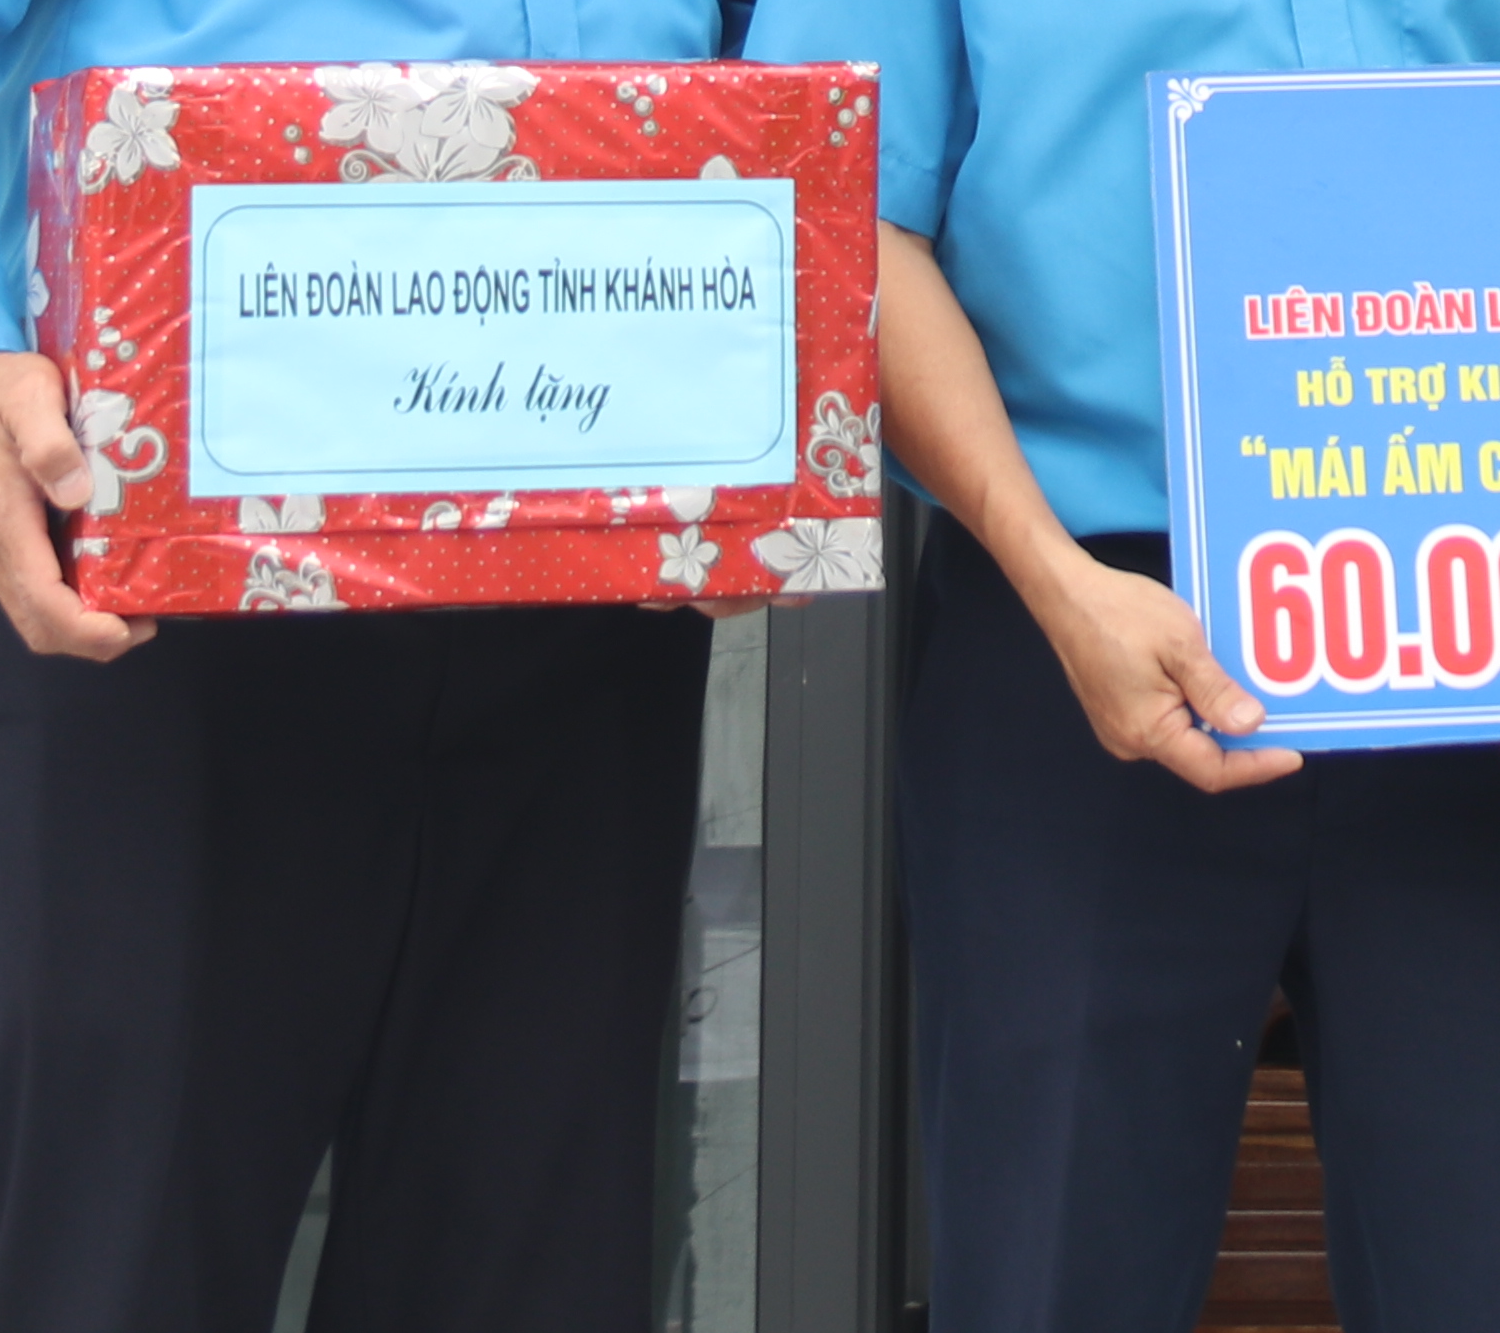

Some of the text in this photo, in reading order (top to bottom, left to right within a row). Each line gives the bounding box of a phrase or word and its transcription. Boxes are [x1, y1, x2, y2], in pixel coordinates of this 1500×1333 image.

[239, 256, 757, 326] LIÊN ĐOÀN LAO ĐỘNG TỈNH KHÁNH HÒA
[1246, 286, 1344, 338] LIÊN
[1353, 282, 1476, 334] ĐOÀN
[392, 360, 612, 434] Kính tặng
[1296, 356, 1353, 407] HỖ
[1364, 362, 1446, 410] TRỢ
[1383, 426, 1463, 496] ẤM
